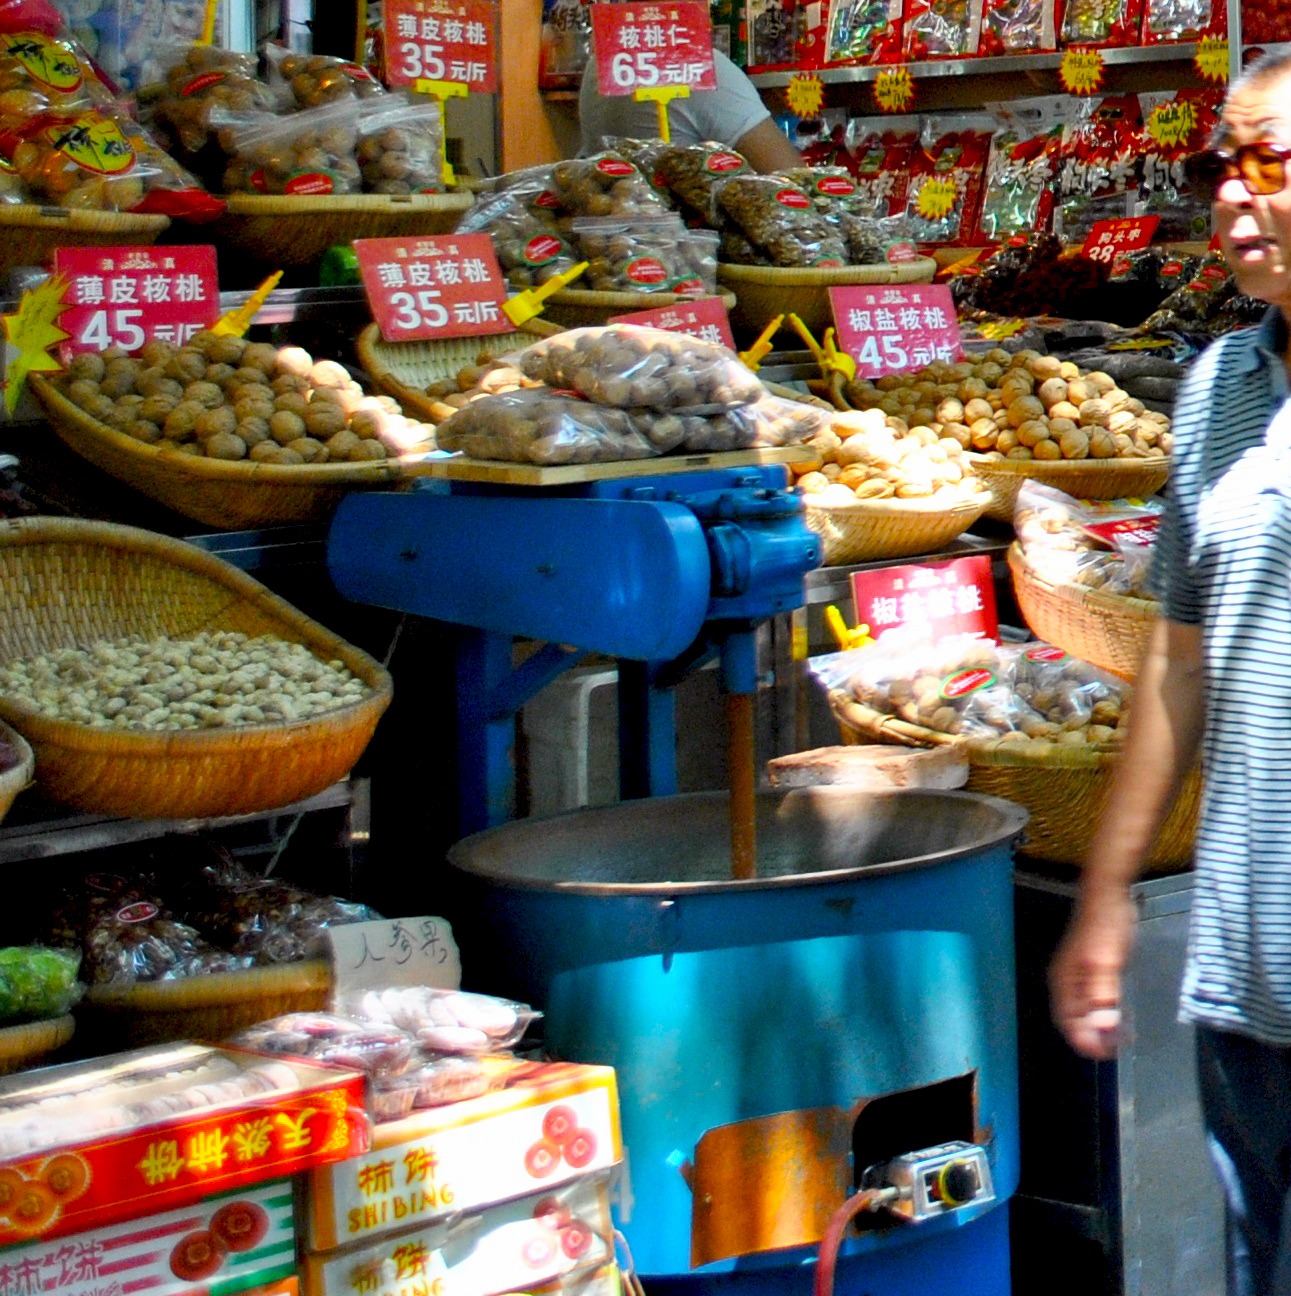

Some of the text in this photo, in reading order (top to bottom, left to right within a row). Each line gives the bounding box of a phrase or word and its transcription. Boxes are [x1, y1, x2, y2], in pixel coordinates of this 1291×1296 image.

[397, 13, 489, 46] 薄皮核桃
[618, 23, 691, 48] 核桃仁
[401, 42, 487, 82] 35 元/斤
[612, 51, 705, 87] 65 元/斤
[77, 272, 206, 305] 薄皮核桃
[378, 256, 492, 290] 薄皮核桃
[389, 289, 499, 330] 35 元/斤
[848, 306, 949, 334] 椒盐核桃
[81, 309, 145, 353] 45
[858, 334, 908, 370] 45
[136, 1106, 316, 1186] 天然柿饼
[358, 1145, 440, 1196] 柿饼
[347, 1182, 455, 1234] SHIBING
[350, 1239, 431, 1294] 柿饼
